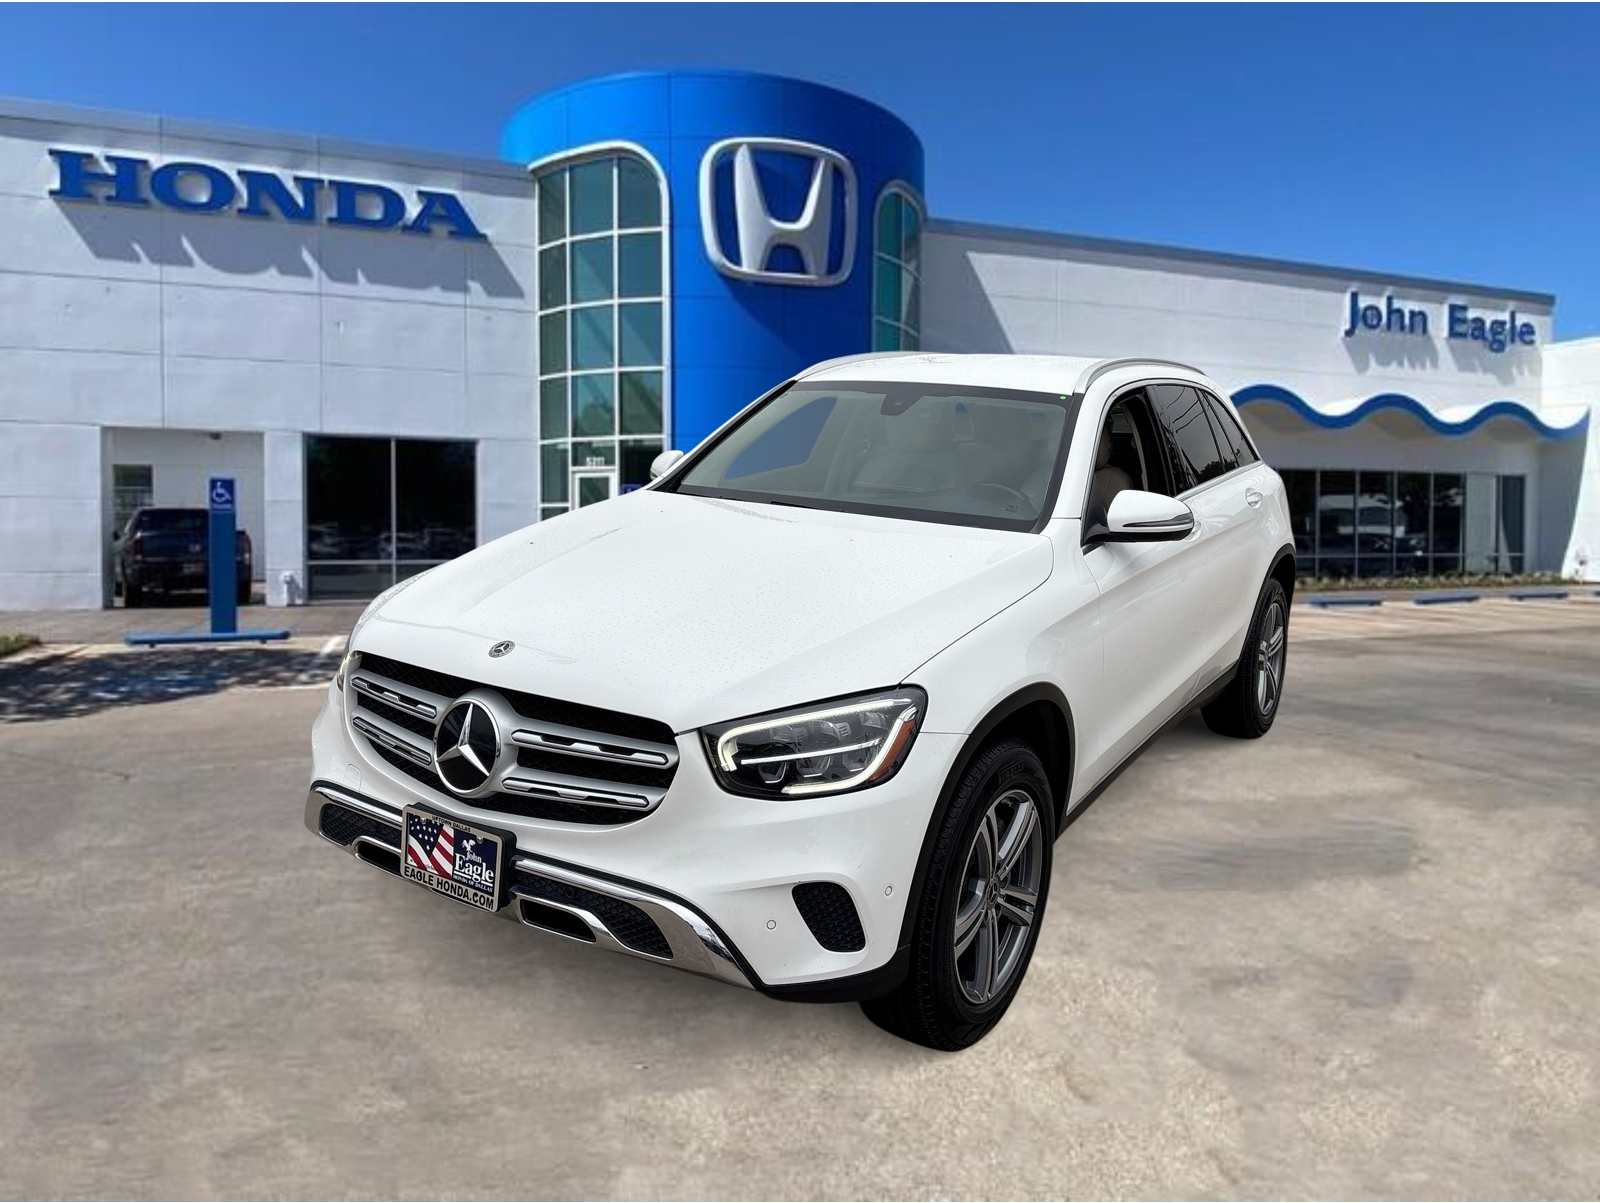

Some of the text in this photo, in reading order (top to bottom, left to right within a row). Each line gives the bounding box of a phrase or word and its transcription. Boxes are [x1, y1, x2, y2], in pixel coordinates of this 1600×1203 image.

[48, 149, 488, 241] HONDA
[1344, 291, 1536, 353] John Eagle
[452, 822, 471, 832] DALLAS
[454, 853, 494, 882] Eagle
[466, 851, 482, 863] John
[404, 866, 494, 910] EAGLE HONDA.COM
